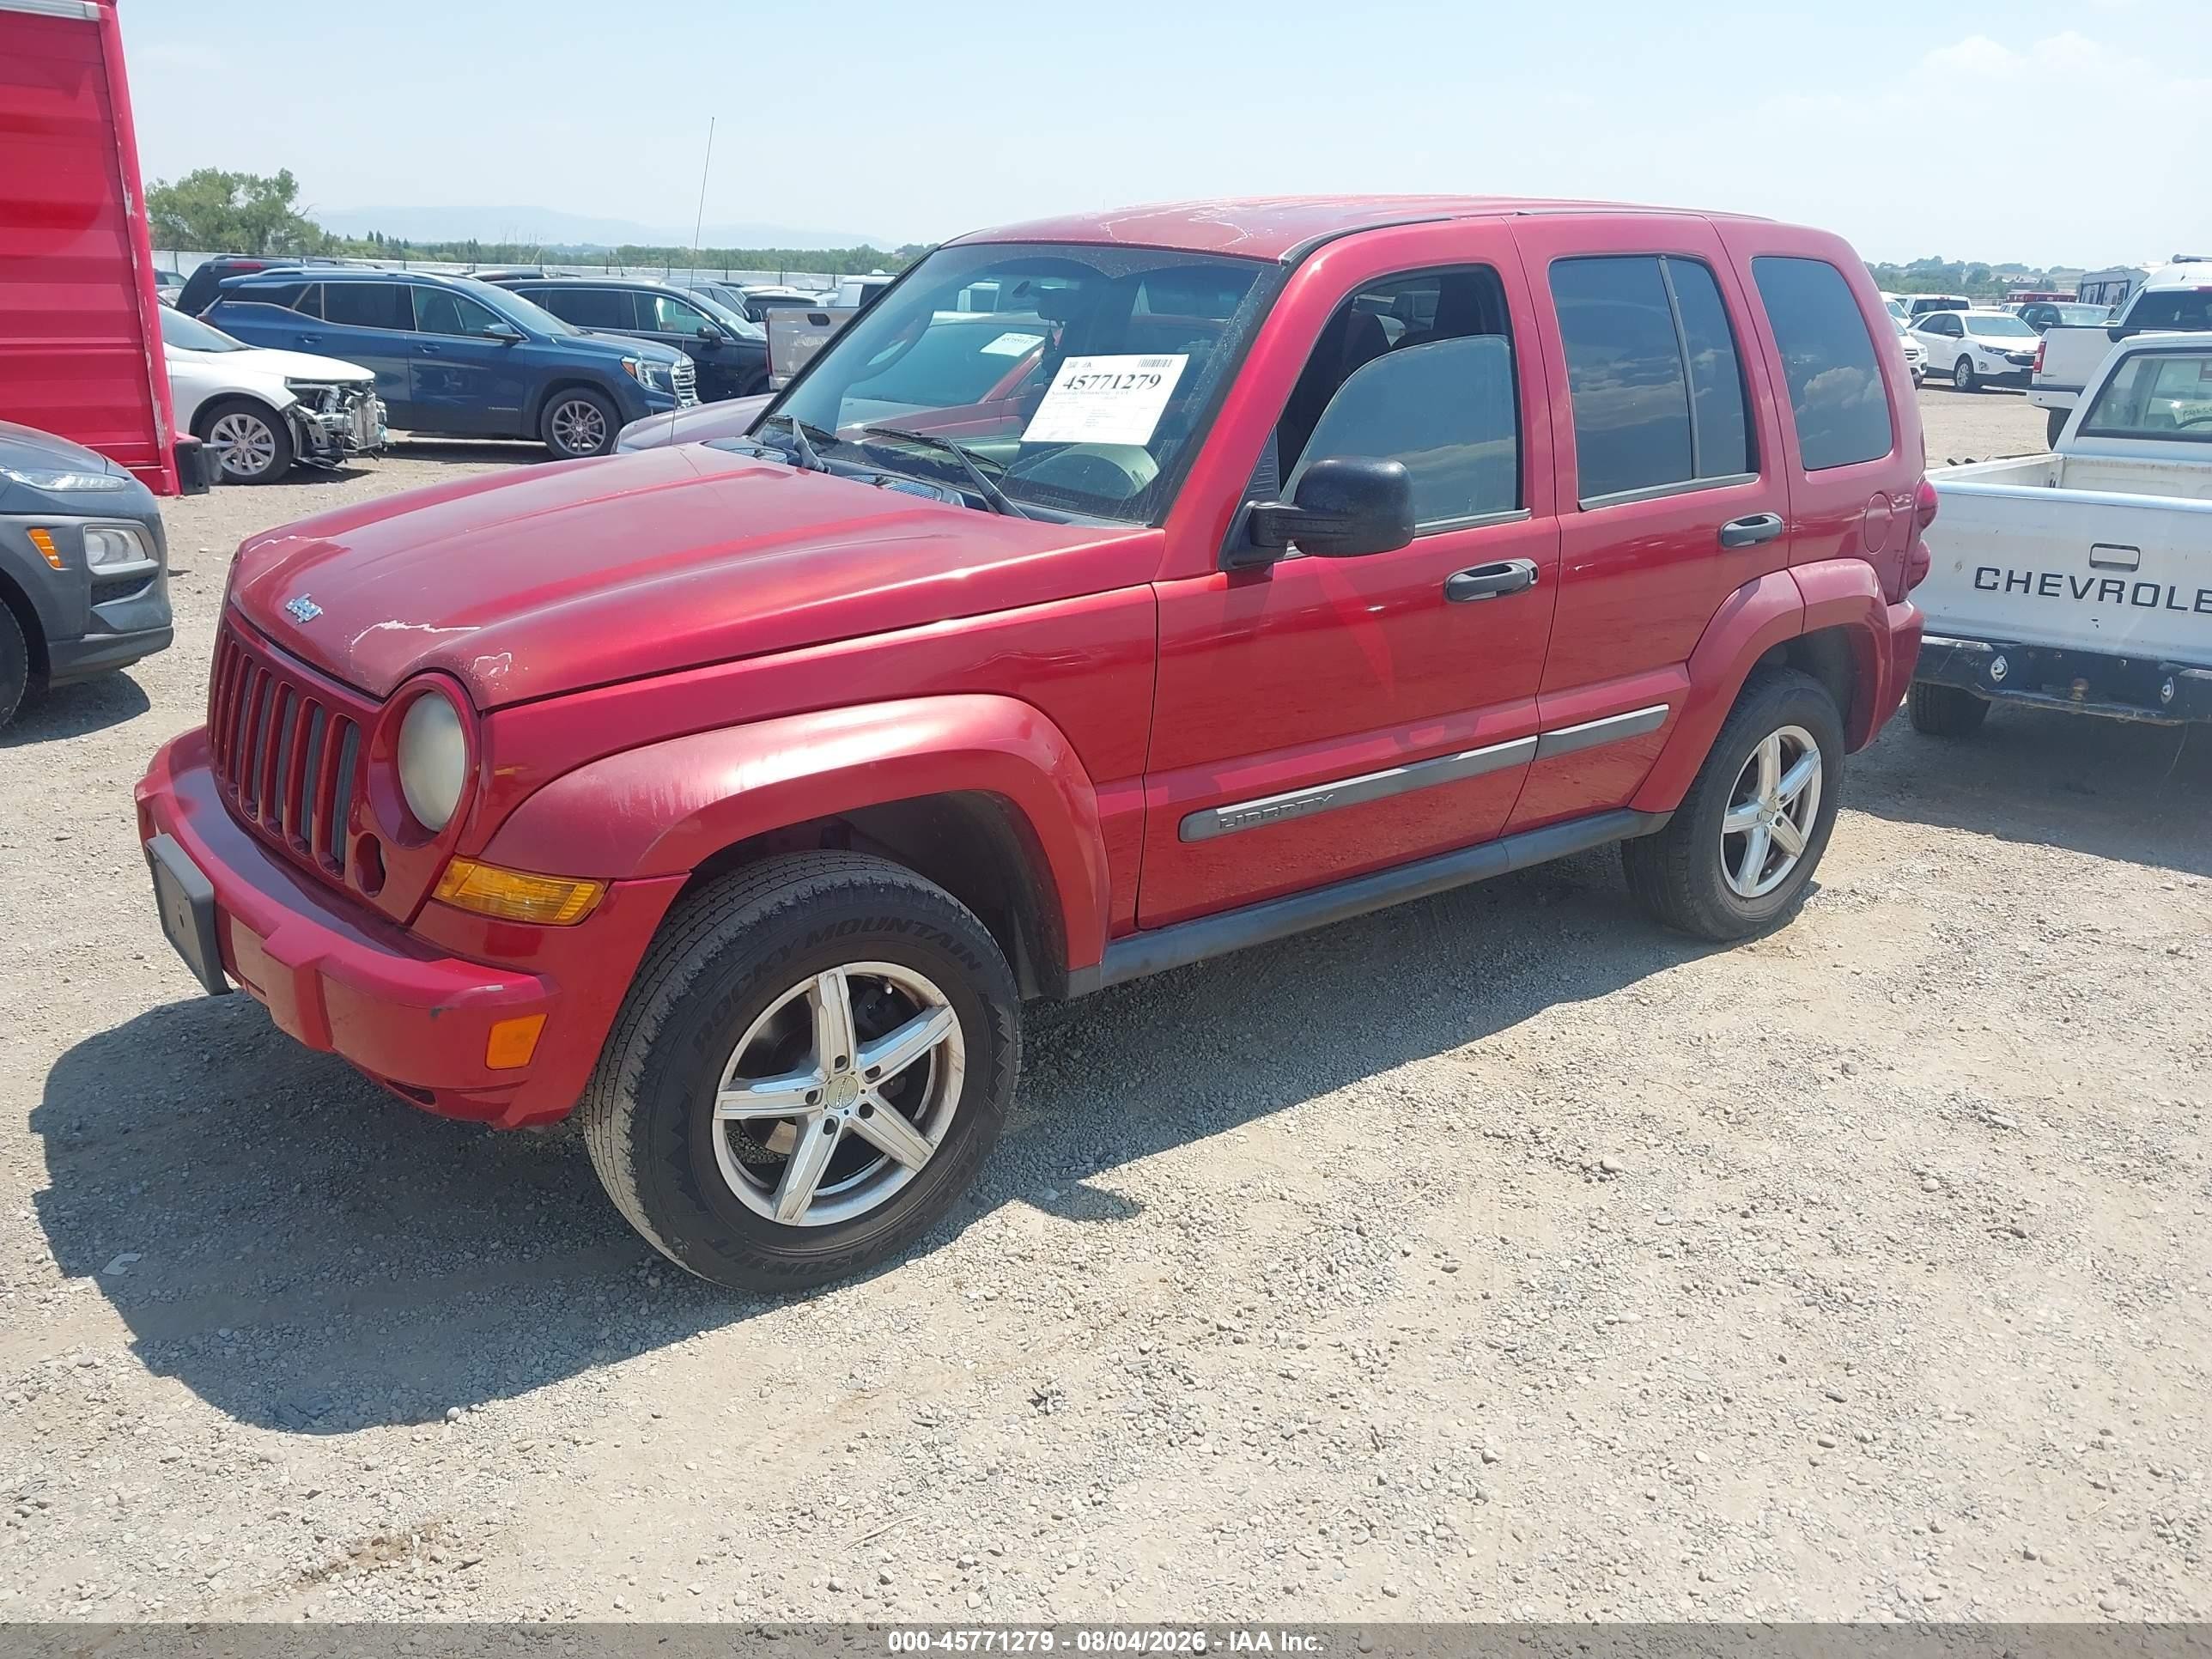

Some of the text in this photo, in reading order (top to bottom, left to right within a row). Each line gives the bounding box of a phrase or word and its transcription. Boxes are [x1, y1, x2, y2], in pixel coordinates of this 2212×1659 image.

[1063, 374, 1162, 390] 45771279
[1975, 566, 2212, 614] CHEVROLE
[1218, 793, 1334, 830] LIBERTY
[690, 915, 984, 1055] ROCKY MOUNTAIN
